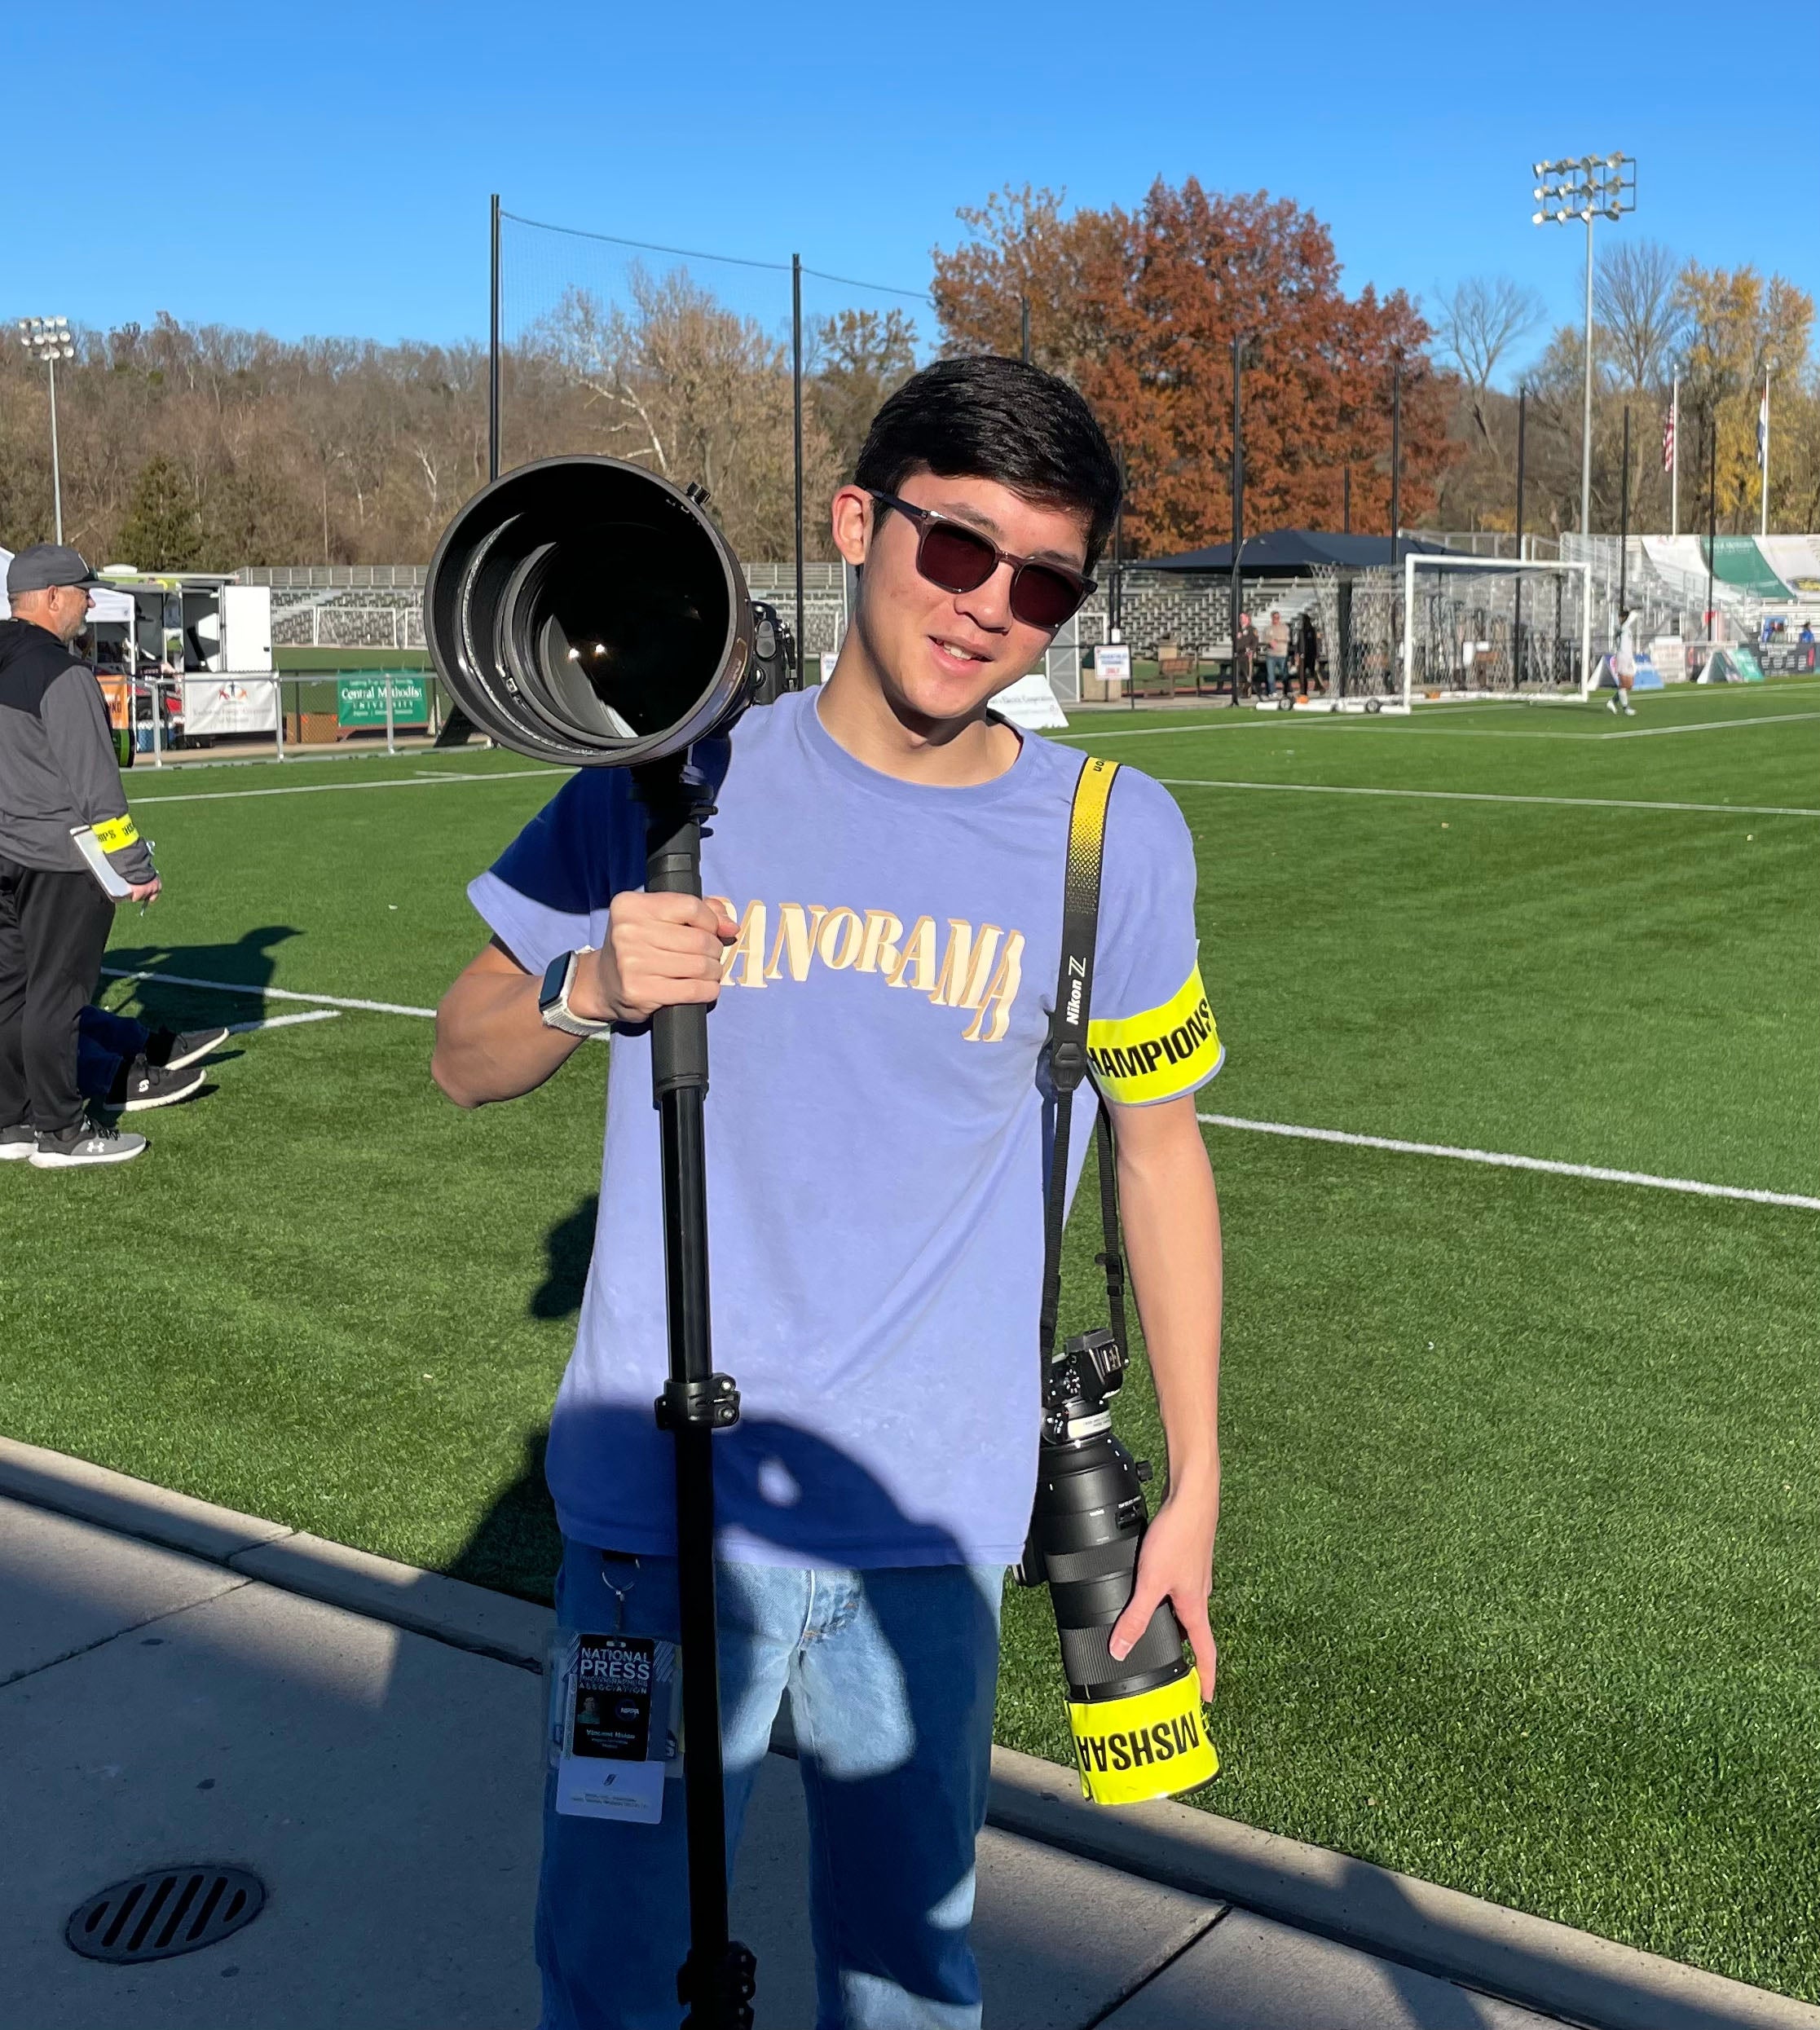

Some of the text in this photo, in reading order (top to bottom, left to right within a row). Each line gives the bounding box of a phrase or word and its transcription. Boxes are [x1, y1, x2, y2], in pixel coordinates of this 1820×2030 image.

[342, 685, 422, 699] Central Mthodist
[353, 700, 413, 709] UNIVESITY
[1066, 955, 1086, 1025] Nikon Z
[1088, 997, 1212, 1078] HAMPIONS
[581, 1647, 651, 1664] NATIONAL
[580, 1659, 650, 1680] PRESS
[579, 1682, 647, 1694] ASSOCIATION
[1075, 1710, 1201, 1772] MSHSAA
